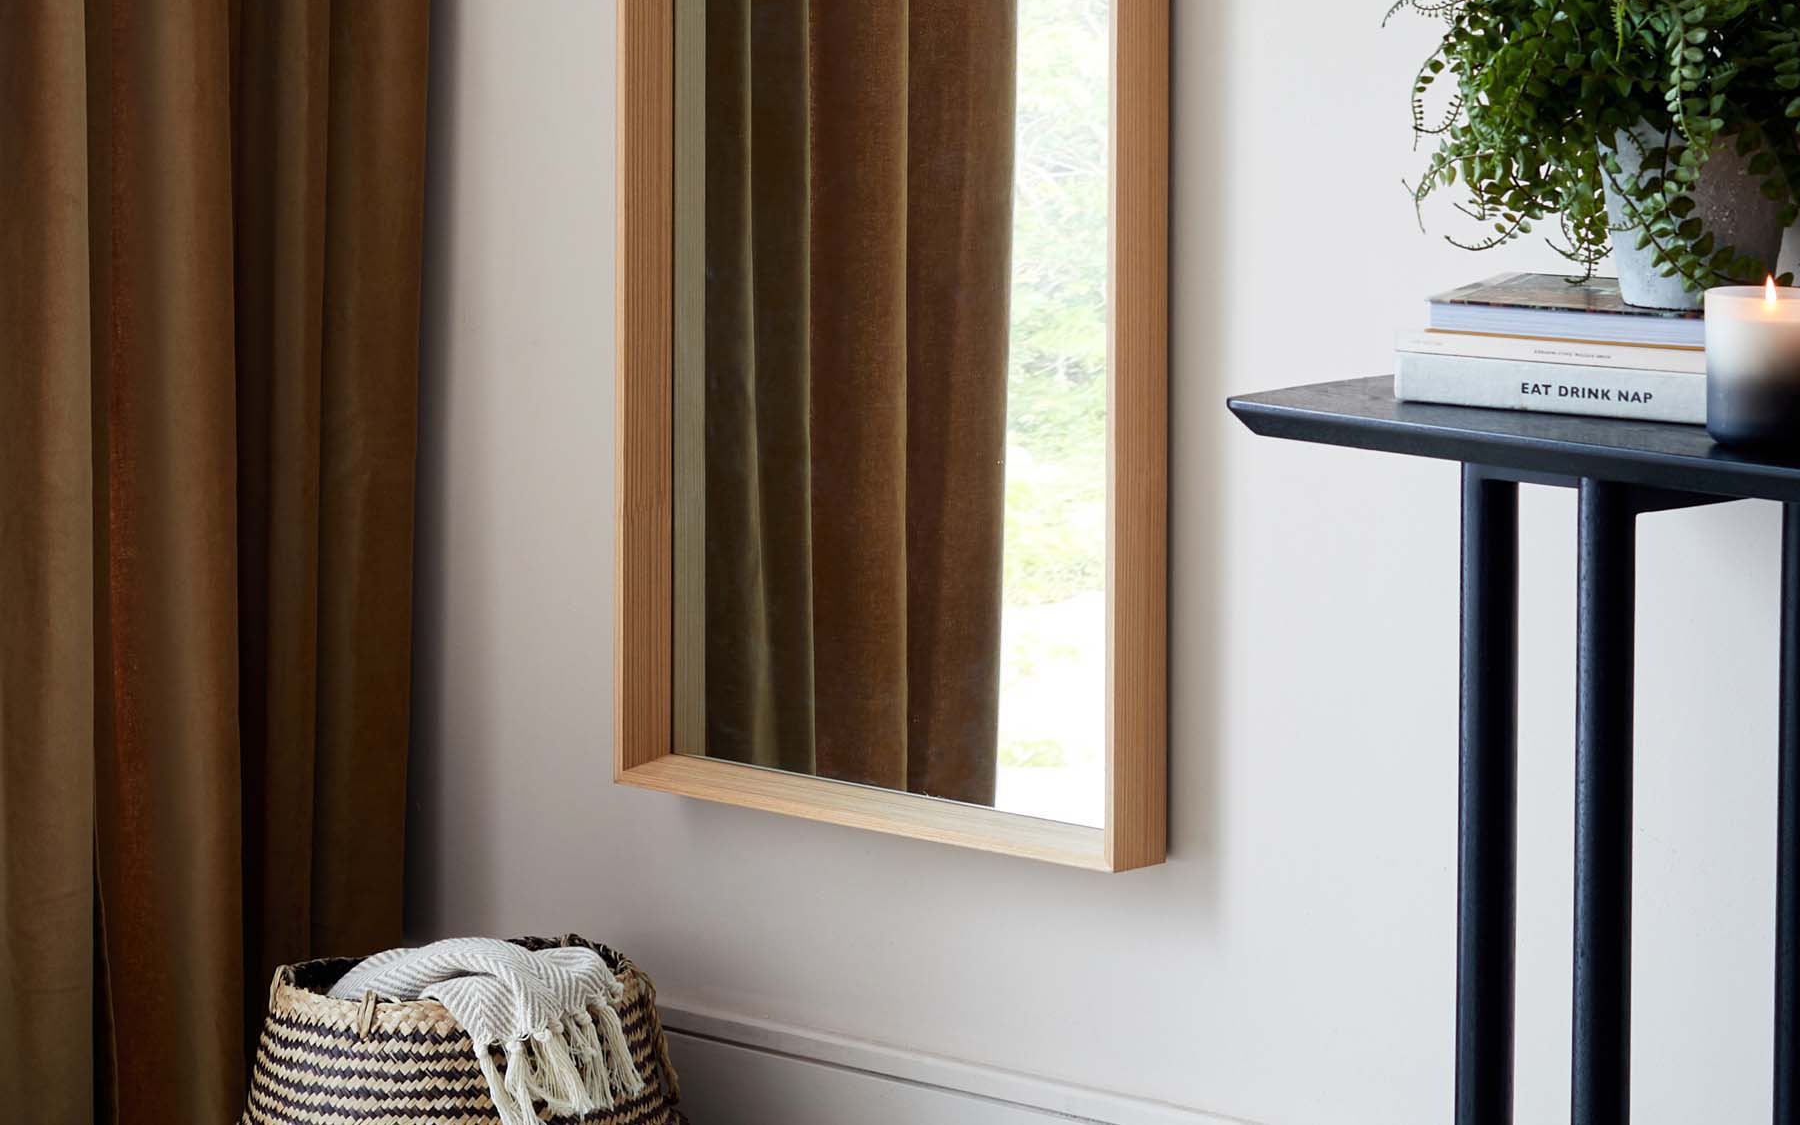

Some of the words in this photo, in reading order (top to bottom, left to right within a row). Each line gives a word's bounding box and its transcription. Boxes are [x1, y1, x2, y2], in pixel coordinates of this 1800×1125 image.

[1520, 382, 1553, 396] EAT
[1558, 385, 1611, 401] DRINK
[1617, 389, 1653, 404] NAP
